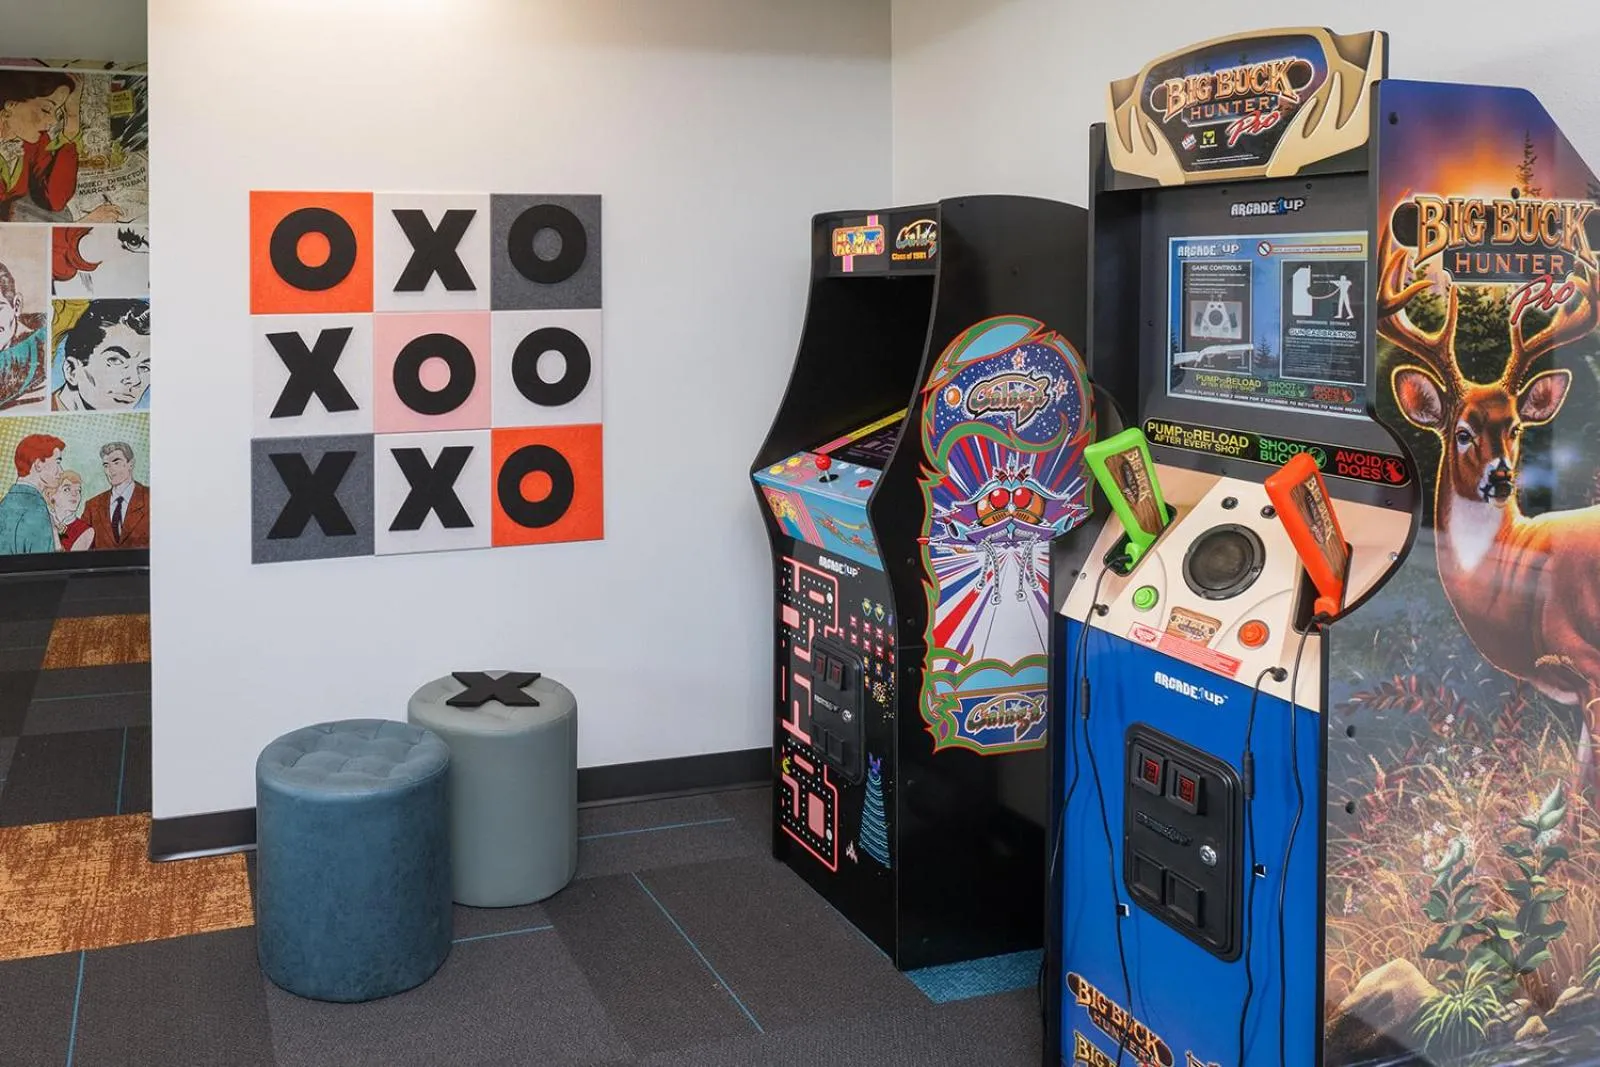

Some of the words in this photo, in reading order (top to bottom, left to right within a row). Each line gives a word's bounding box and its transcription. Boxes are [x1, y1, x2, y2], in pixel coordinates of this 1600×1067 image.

[1164, 78, 1213, 121] BIG
[1215, 58, 1298, 103] BUCK
[1190, 96, 1271, 120] HUNTER
[1415, 196, 1486, 266] BIG
[1492, 199, 1598, 269] BUCK
[1454, 252, 1565, 275] HUNTER
[1147, 422, 1183, 437] PUMP
[1194, 429, 1249, 449] RELOAD
[1154, 433, 1181, 445] AFTER
[1184, 439, 1212, 451] EVERY
[1215, 443, 1241, 456] SHOT
[1259, 438, 1307, 453] SHOOT
[1335, 451, 1381, 468] AVOID
[1338, 463, 1380, 480] DOES
[1076, 976, 1108, 1016] BIG
[1110, 1002, 1161, 1067] BUCK
